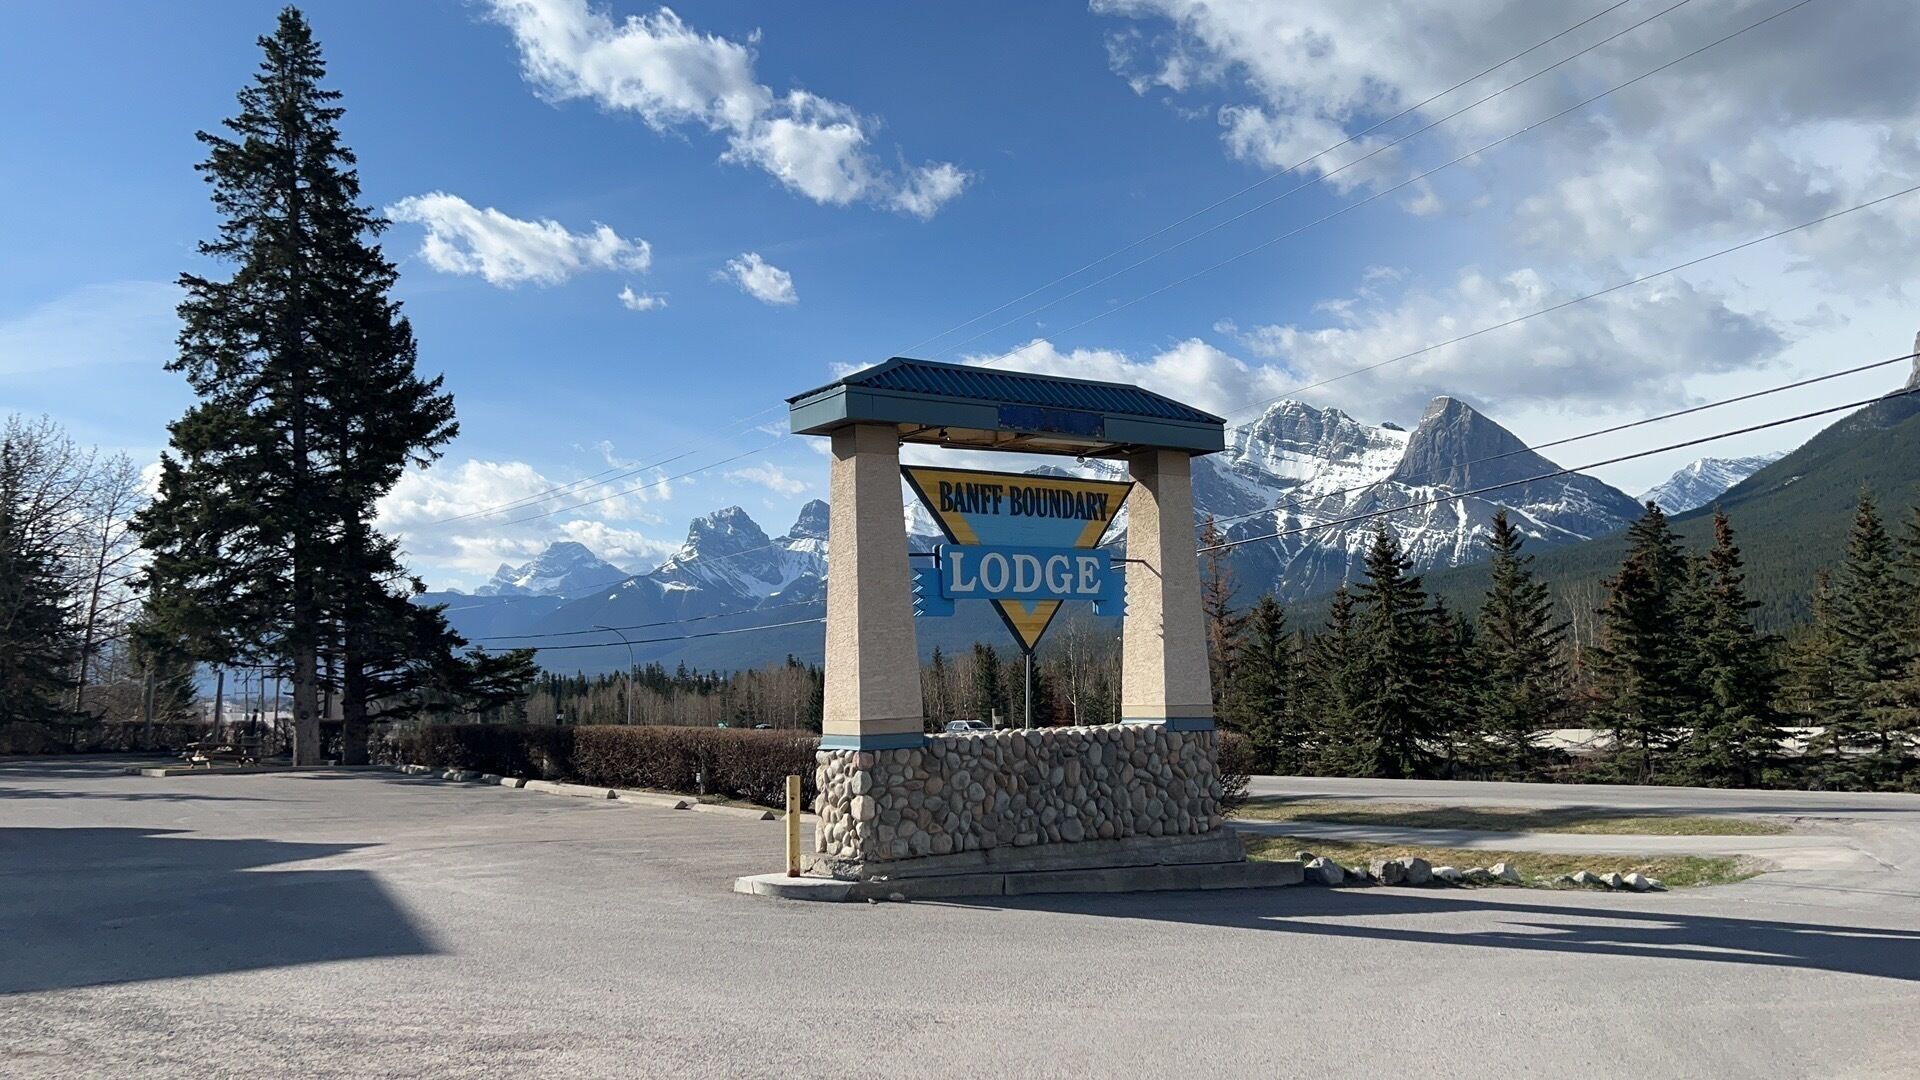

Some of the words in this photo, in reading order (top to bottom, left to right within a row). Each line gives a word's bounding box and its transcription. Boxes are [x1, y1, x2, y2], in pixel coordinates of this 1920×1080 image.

[940, 482, 1002, 514] BANFF
[1009, 486, 1108, 521] BOUNDARY
[951, 552, 1101, 594] LODGE
